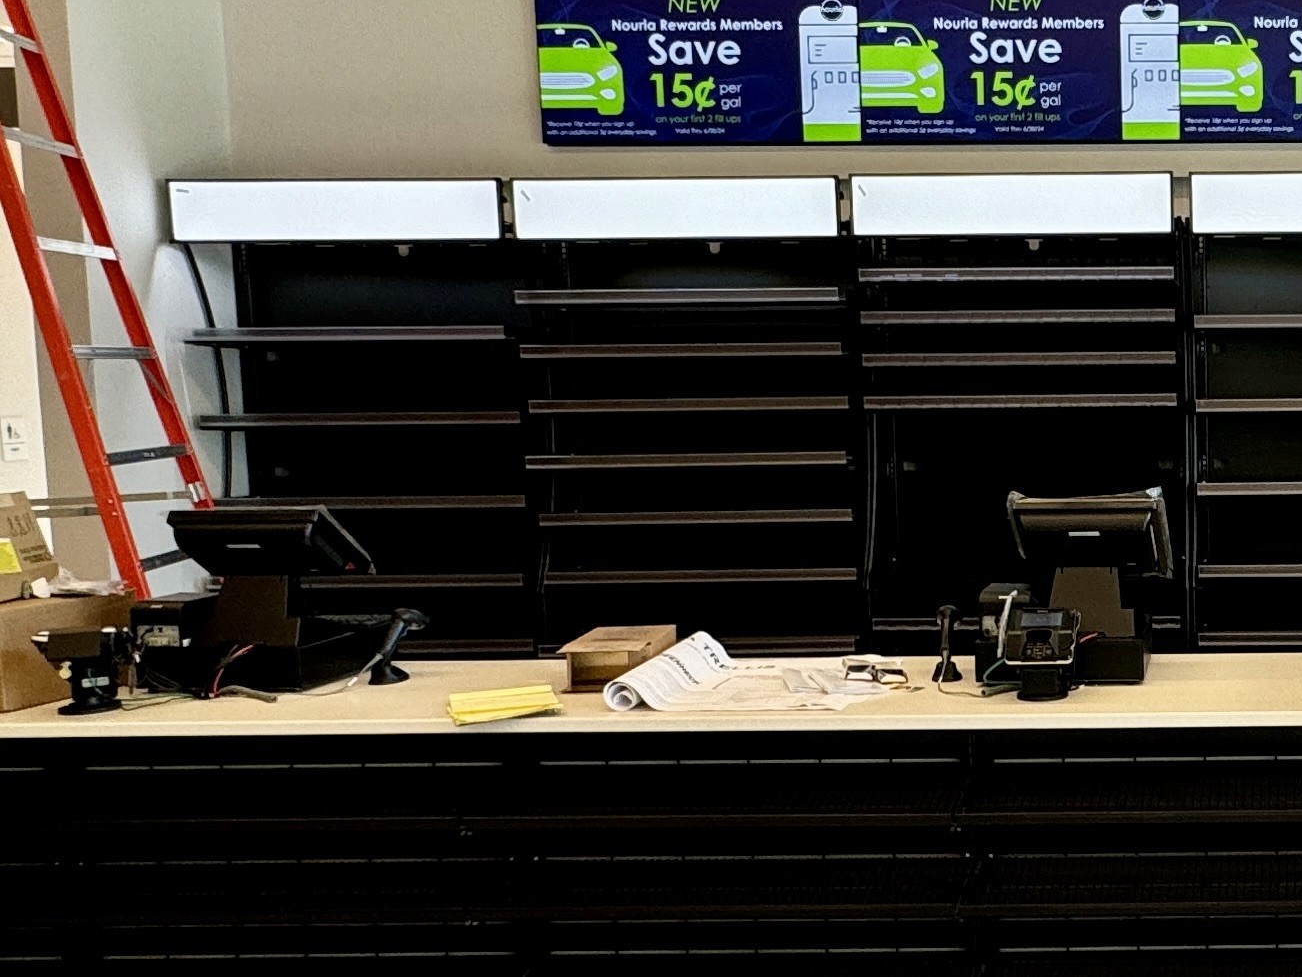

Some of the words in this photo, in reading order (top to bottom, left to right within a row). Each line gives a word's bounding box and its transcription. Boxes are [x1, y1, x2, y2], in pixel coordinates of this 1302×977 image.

[612, 19, 656, 31] Nouria
[660, 19, 716, 31] Rewards
[719, 18, 783, 31] Members
[934, 17, 978, 30] Nouria
[982, 17, 1038, 30] Rewards
[1041, 17, 1104, 29] Members
[1254, 16, 1298, 28] Nouria
[648, 33, 741, 65] Save
[969, 31, 1062, 63] Save
[650, 73, 716, 111] 15¢
[719, 83, 742, 94] per
[970, 71, 1036, 109] 15¢
[1040, 82, 1062, 93] per
[721, 98, 741, 110] gal
[1041, 96, 1061, 108] gal
[669, 116, 689, 124] your
[691, 115, 705, 123] first
[707, 115, 713, 123] 2
[715, 114, 723, 123] fill
[725, 116, 742, 124] ups
[989, 114, 1008, 122] your
[1010, 113, 1025, 121] first
[1027, 113, 1032, 121] 2
[1034, 113, 1043, 121] fill
[1045, 114, 1061, 122] ups
